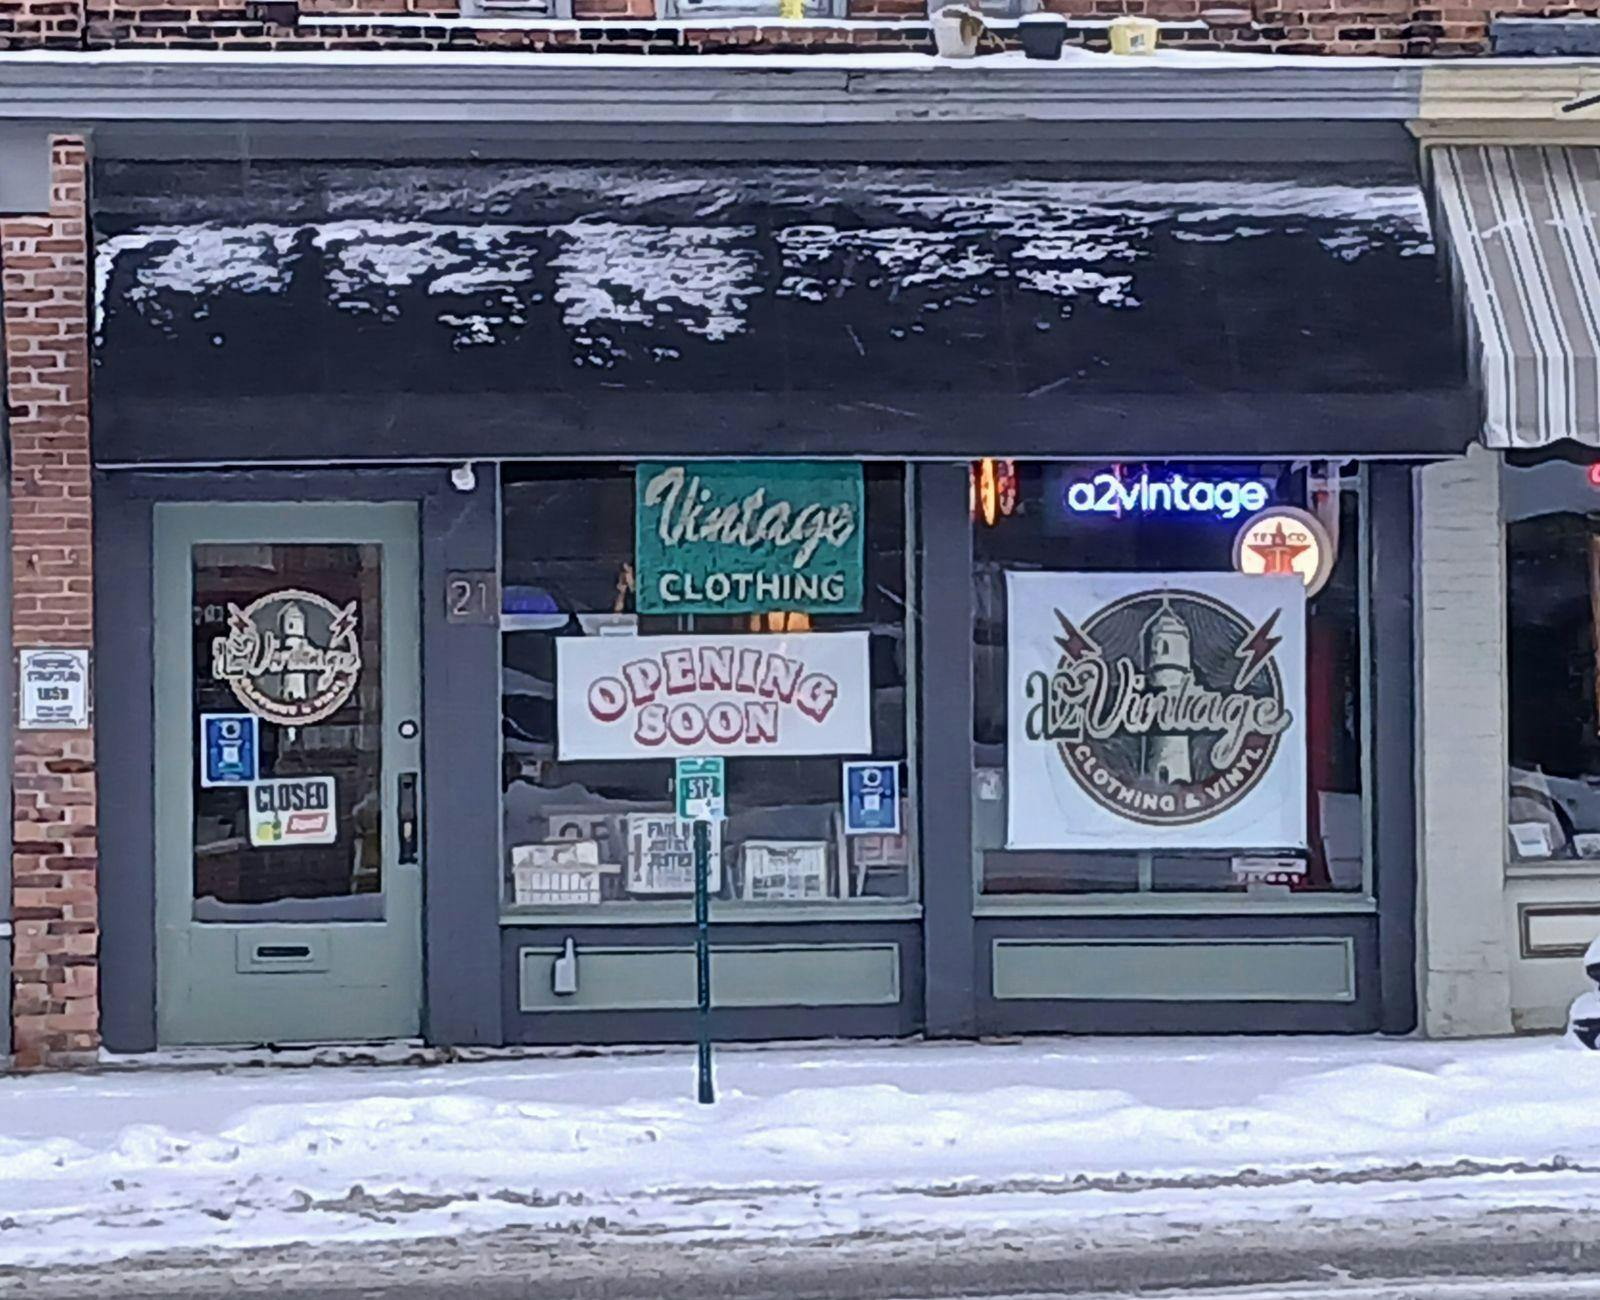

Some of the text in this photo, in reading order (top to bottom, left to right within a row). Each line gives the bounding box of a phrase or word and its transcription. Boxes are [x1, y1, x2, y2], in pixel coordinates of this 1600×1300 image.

[645, 467, 855, 569] Vintage
[1068, 474, 1268, 518] a2vintage
[451, 581, 486, 615] 21
[659, 572, 845, 602] CLOTHING
[588, 646, 838, 724] OPENING
[634, 701, 779, 747] SOON
[1062, 657, 1293, 769] Vintage
[255, 781, 329, 813] CLOSED
[1074, 744, 1176, 812] CLOTHING
[1204, 746, 1264, 801] VINYL
